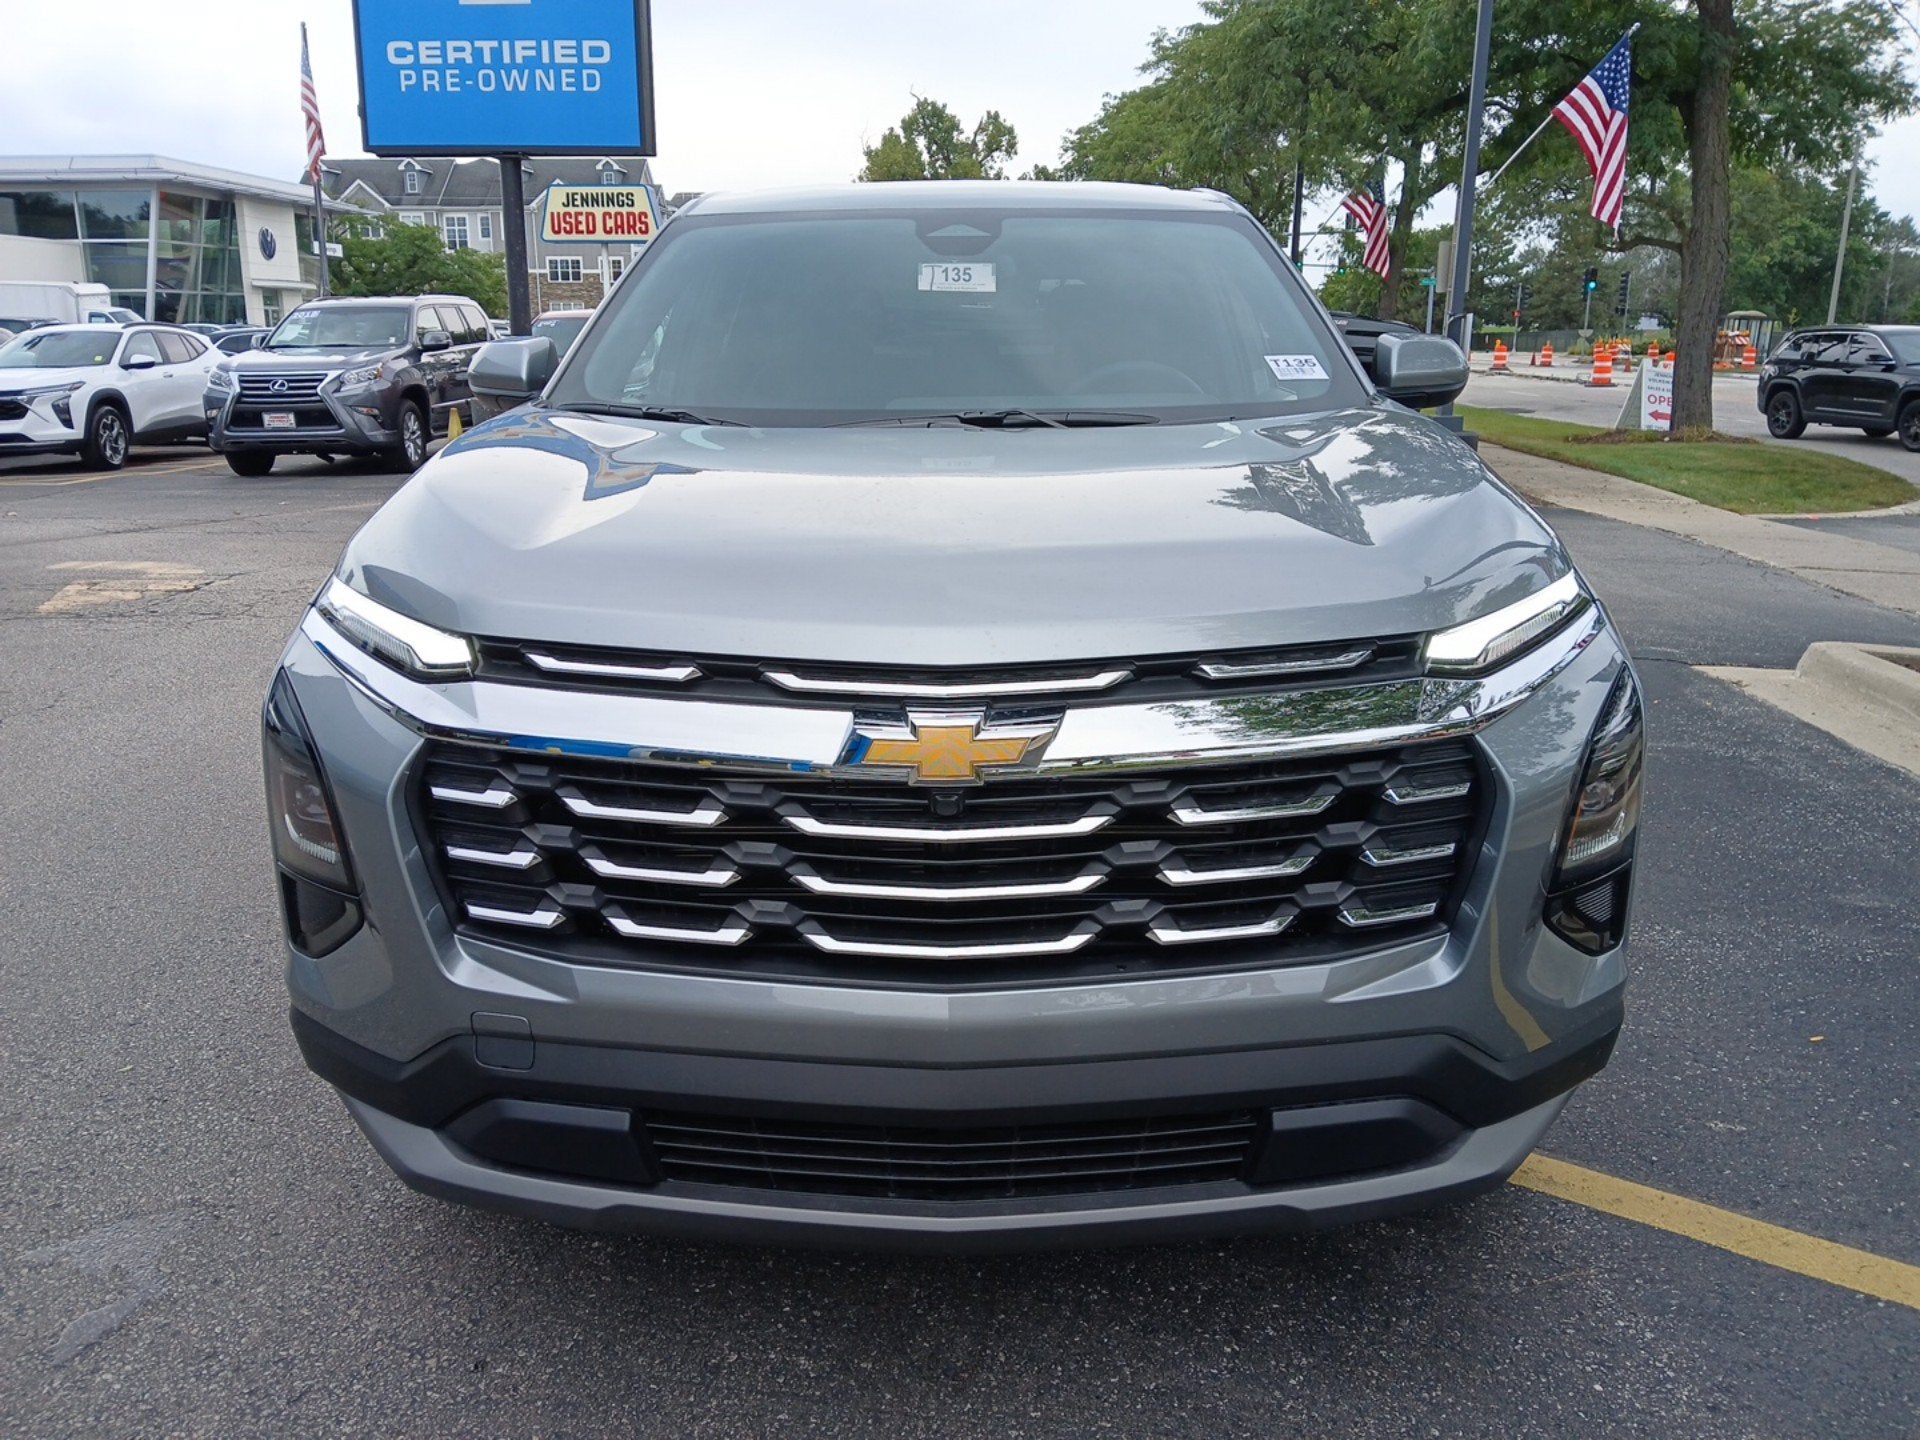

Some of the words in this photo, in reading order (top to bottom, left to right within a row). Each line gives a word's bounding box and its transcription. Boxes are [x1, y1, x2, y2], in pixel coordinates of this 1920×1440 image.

[386, 40, 611, 64] CERTIFIED
[400, 69, 601, 91] PRE-OWNED
[562, 192, 635, 207] JENNINGS
[550, 211, 597, 235] USED
[602, 211, 650, 235] CARS
[1270, 359, 1317, 368] T135
[1647, 394, 1672, 407] OPE
